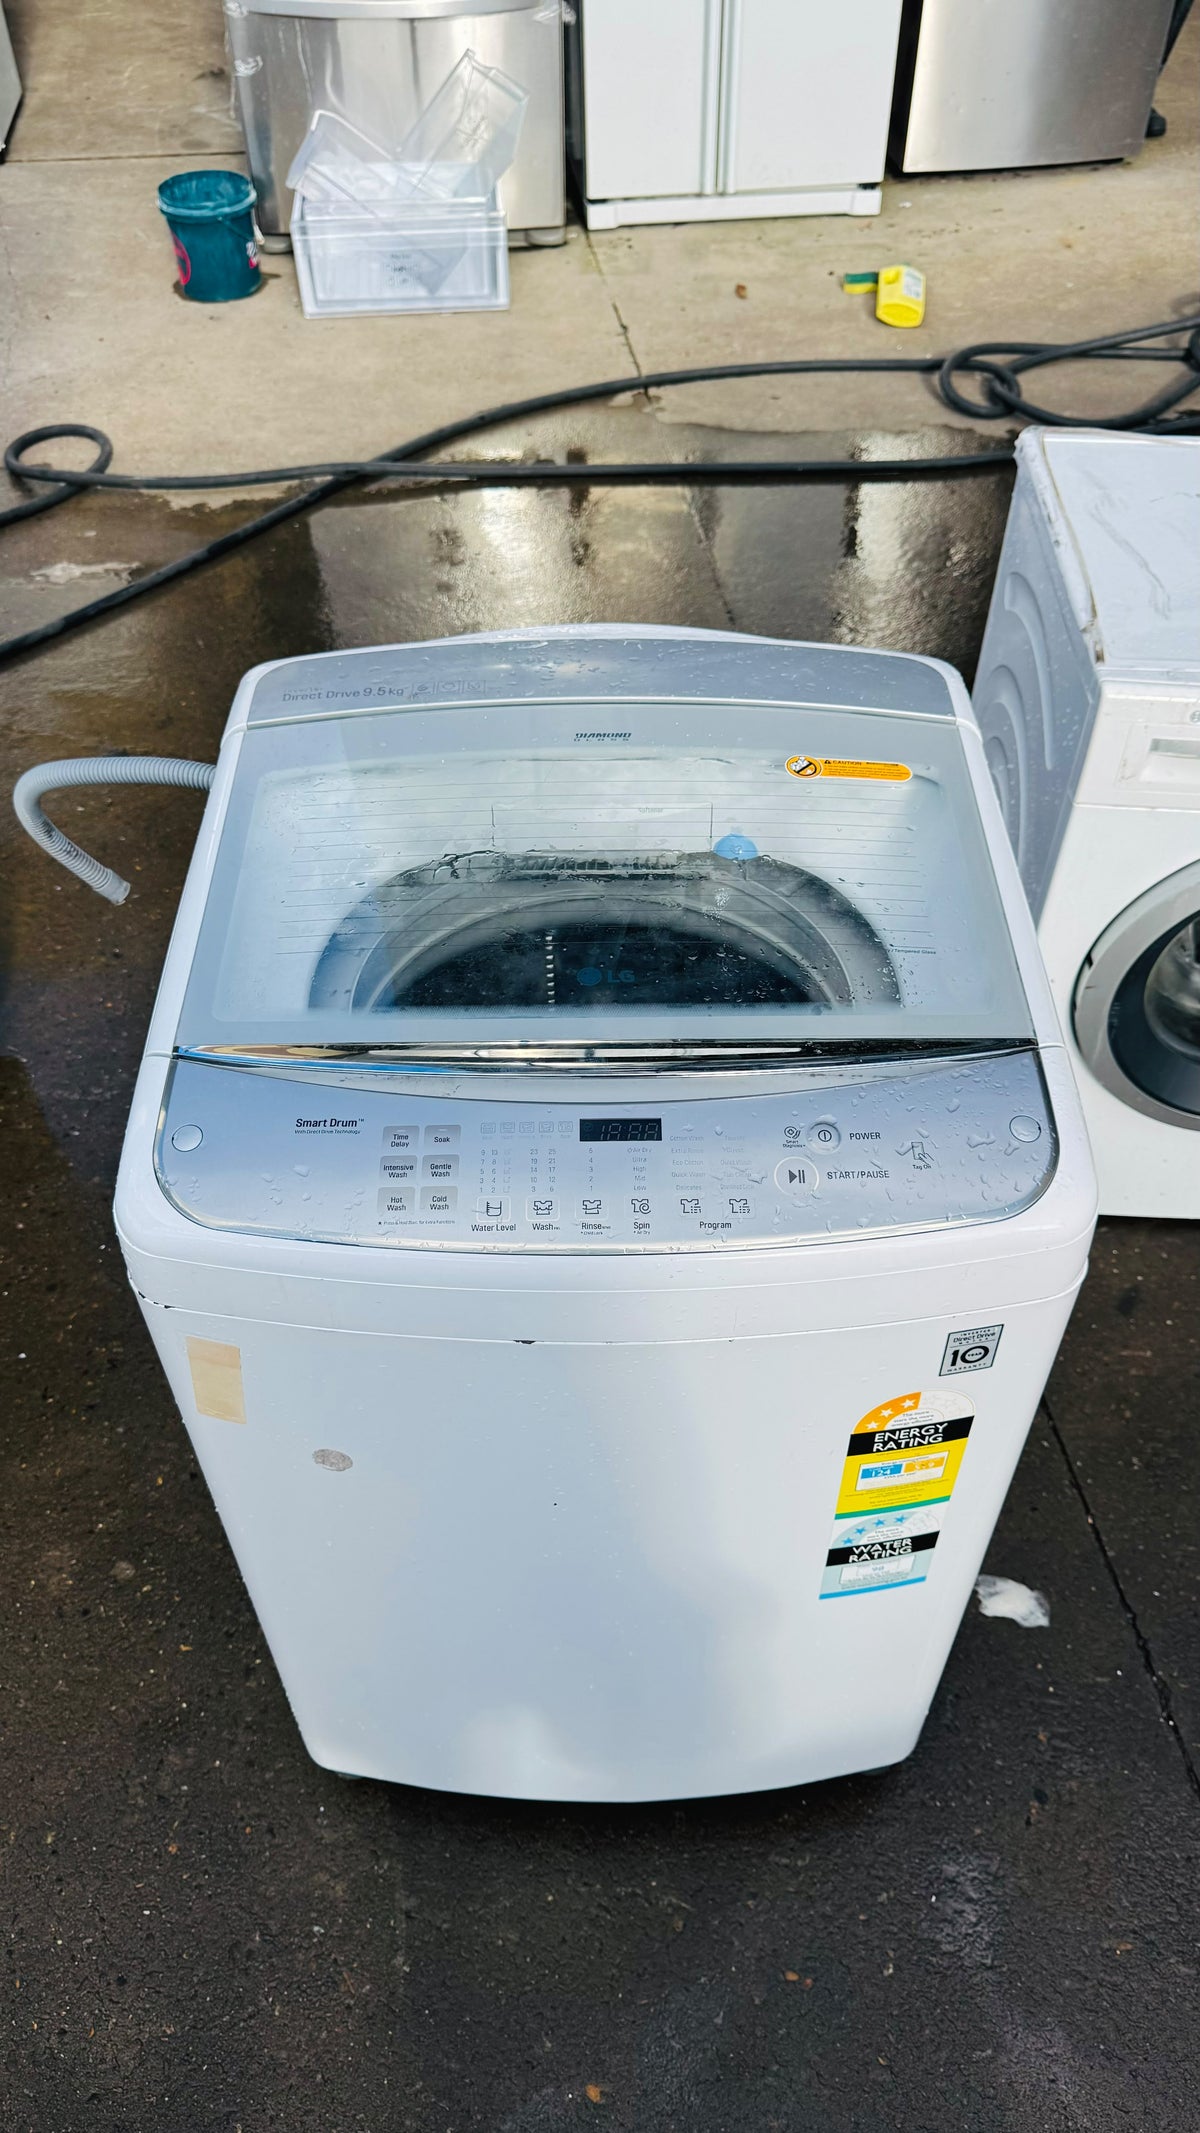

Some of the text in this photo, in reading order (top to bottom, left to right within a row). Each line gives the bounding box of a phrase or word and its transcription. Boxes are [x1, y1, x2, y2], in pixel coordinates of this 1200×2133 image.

[283, 692, 322, 702] Direct
[326, 689, 361, 699] Drive
[607, 969, 636, 983] LG
[296, 1118, 328, 1128] Smart
[850, 1132, 881, 1140] POWER
[827, 1170, 890, 1179] START/PAUSE
[495, 1224, 516, 1232] Level
[532, 1223, 554, 1231] Wash
[581, 1222, 602, 1230] Rinse
[633, 1222, 650, 1231] Spin
[699, 1221, 732, 1230] Program
[953, 1335, 975, 1343] Direct
[950, 1345, 990, 1367] 10
[874, 1422, 949, 1443] ENERGY
[873, 1434, 944, 1453] RATING
[852, 1538, 912, 1555] WATER
[848, 1545, 912, 1564] RATING
